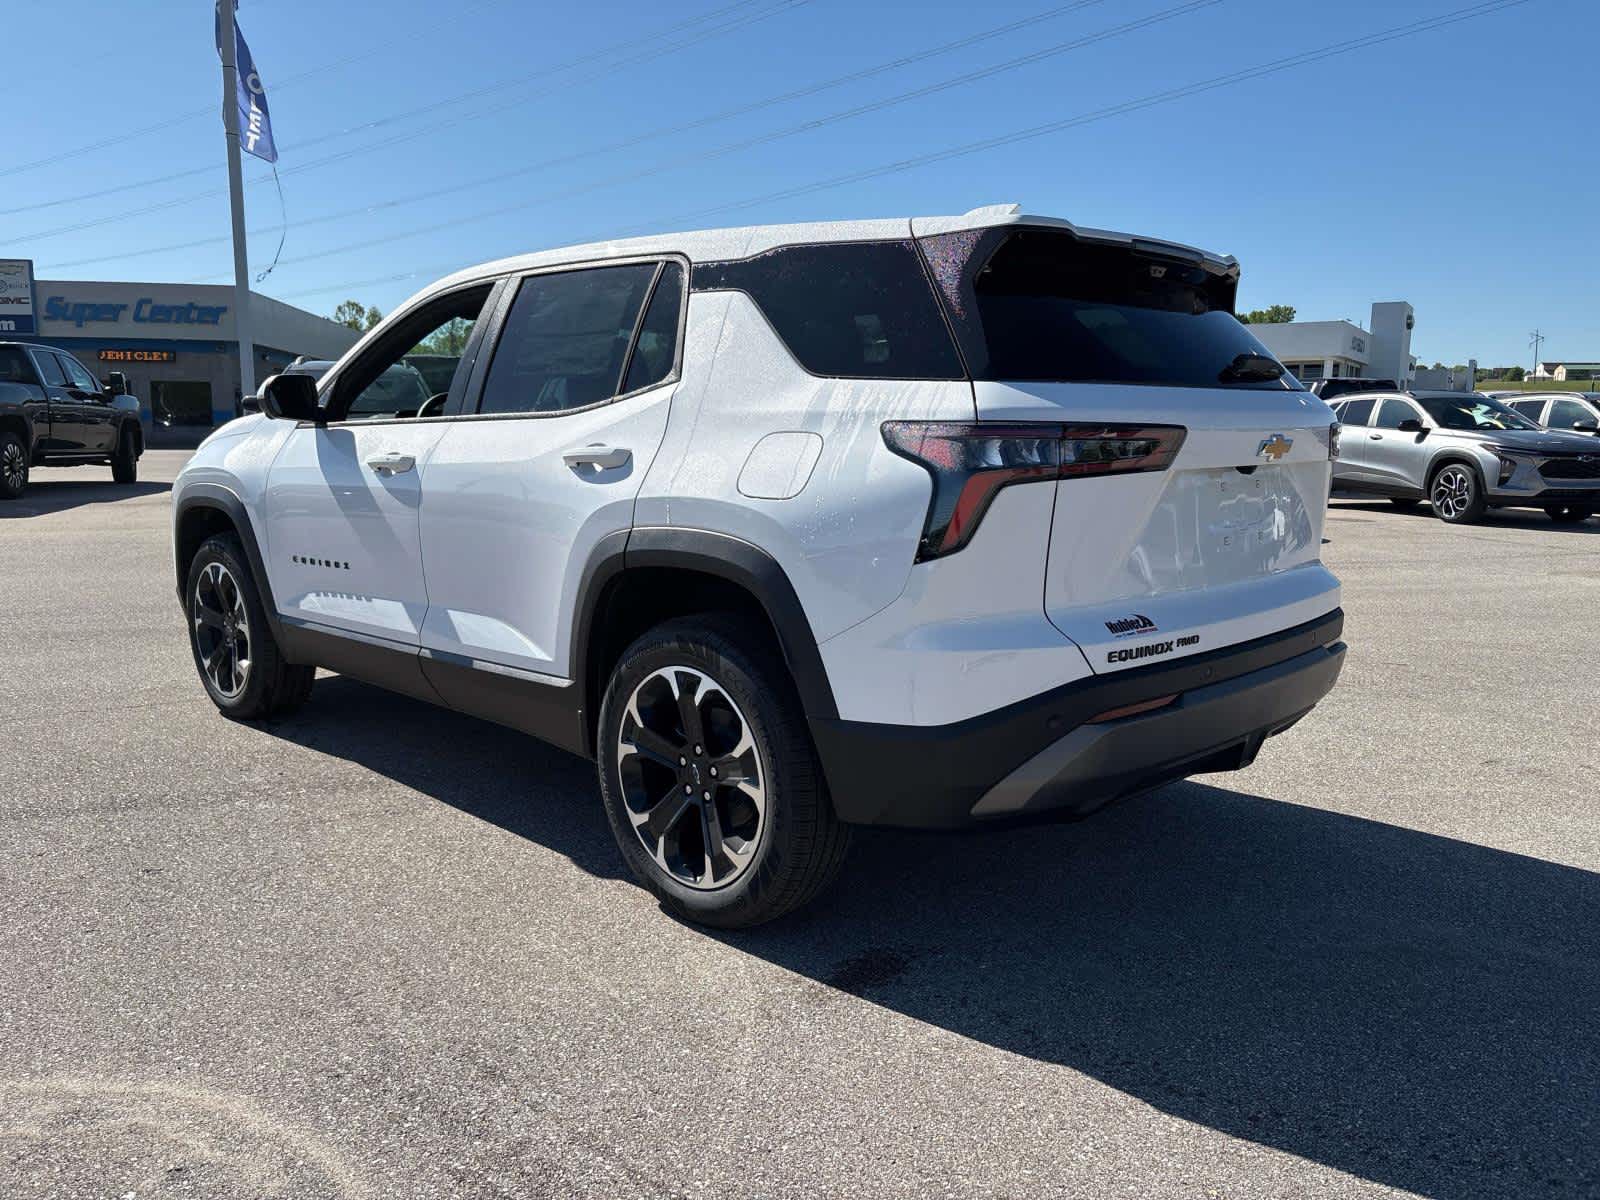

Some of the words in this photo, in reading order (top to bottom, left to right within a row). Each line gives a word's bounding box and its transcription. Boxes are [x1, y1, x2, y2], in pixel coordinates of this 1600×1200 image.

[43, 296, 128, 328] Super
[133, 298, 228, 326] Center
[1107, 641, 1175, 664] EQUINOX
